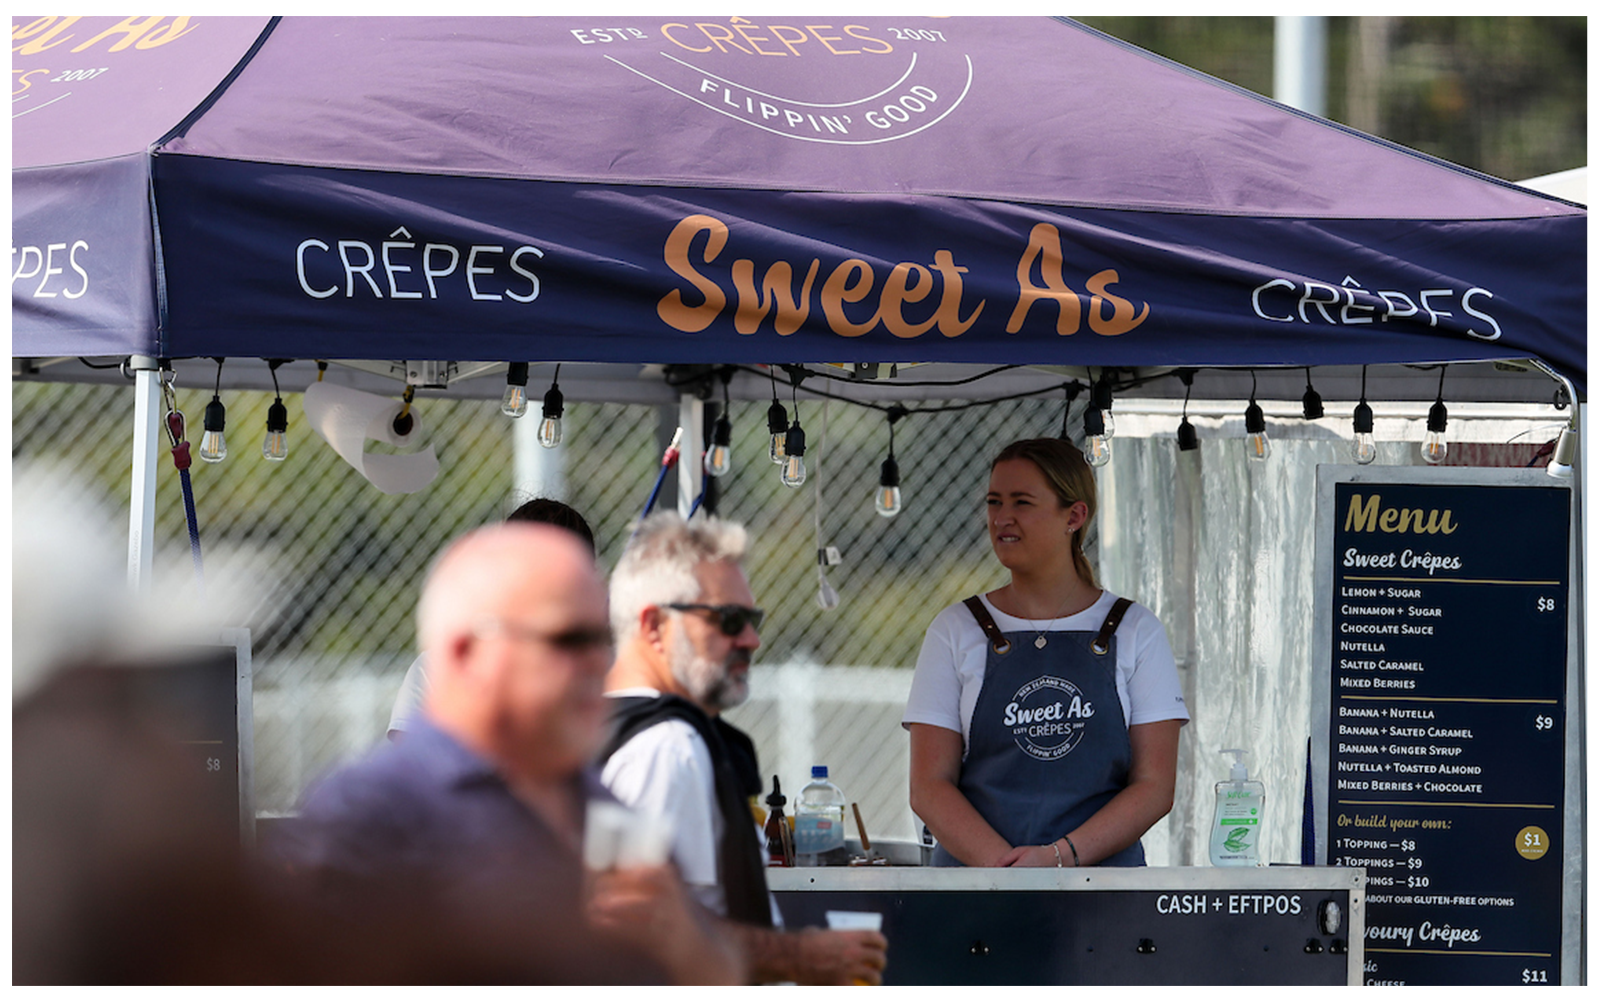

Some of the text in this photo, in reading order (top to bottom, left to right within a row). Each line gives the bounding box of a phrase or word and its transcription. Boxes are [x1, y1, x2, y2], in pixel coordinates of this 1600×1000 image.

[661, 16, 893, 57] CRÊPES
[887, 28, 947, 42] 2007
[50, 67, 109, 82] 2007
[865, 85, 938, 129] GOOD
[12, 240, 89, 299] PES
[296, 226, 544, 303] CRÊPES
[657, 214, 1150, 338] Sweet As
[1345, 494, 1458, 534] Menu
[1343, 548, 1462, 575] Sweet Crêpes
[1342, 587, 1377, 597] LEMON
[1387, 588, 1421, 598] SUGAR
[1341, 605, 1395, 615] CINNAMON
[1408, 606, 1442, 617] SUGAR
[1537, 597, 1554, 611] $8
[1341, 623, 1434, 635] CHOCOLATE SAUCE
[1341, 641, 1385, 651] NUTELLA
[1341, 659, 1424, 671] SALTED CARAMEL
[1340, 678, 1415, 689] MIXED BERRIES
[1003, 695, 1095, 726] Sweet As
[1339, 707, 1379, 717] BANANA
[1390, 708, 1434, 719] NUTELLA
[1536, 715, 1553, 730] $9
[1028, 722, 1072, 738] CRÊPES
[1339, 725, 1379, 736] BANANA
[1390, 726, 1425, 737] SALTED
[1428, 727, 1473, 738] CARAMEL
[1339, 744, 1378, 754] BANANA
[1389, 745, 1427, 755] GINGER
[1429, 745, 1462, 756] SYRUP
[206, 757, 221, 773] $8
[1338, 762, 1383, 772] NUTELLA
[1393, 763, 1437, 773] TOASTED
[1439, 763, 1481, 775] ALMOND
[1338, 780, 1369, 790] MIXED
[1371, 780, 1413, 791] BERRIES
[1424, 782, 1482, 793] CHOCOLATE
[1337, 814, 1452, 832] Or build your own:
[1336, 840, 1341, 848] 1
[1343, 838, 1387, 849] TOPPING
[1401, 838, 1415, 852] $8
[1524, 832, 1541, 846] $1
[1336, 858, 1342, 868] 2
[1344, 857, 1394, 868] TOPPINGS
[1408, 857, 1422, 871] $9
[1408, 876, 1429, 889] $10
[1156, 894, 1302, 914] CASH + EFTPOS
[1365, 895, 1514, 907] ABOUT OUR GLUTEN-FREE OPTIONS
[1419, 922, 1481, 948] Crêpes
[1522, 969, 1547, 983] $11
